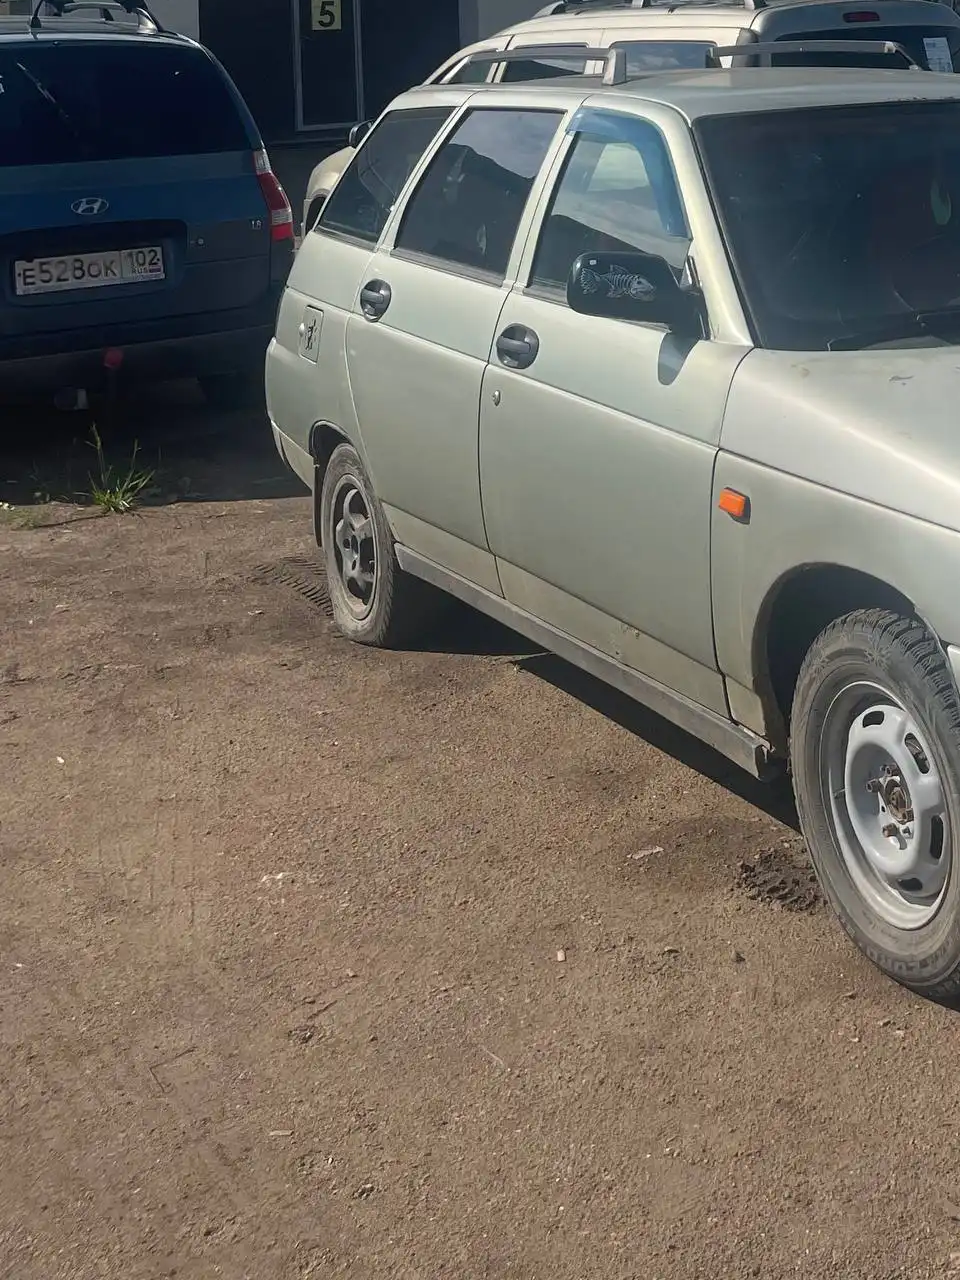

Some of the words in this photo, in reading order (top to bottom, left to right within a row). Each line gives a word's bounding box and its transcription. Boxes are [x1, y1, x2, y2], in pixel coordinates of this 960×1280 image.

[318, 0, 336, 28] 5
[22, 259, 117, 287] Е528ОК
[127, 249, 159, 268] 102
